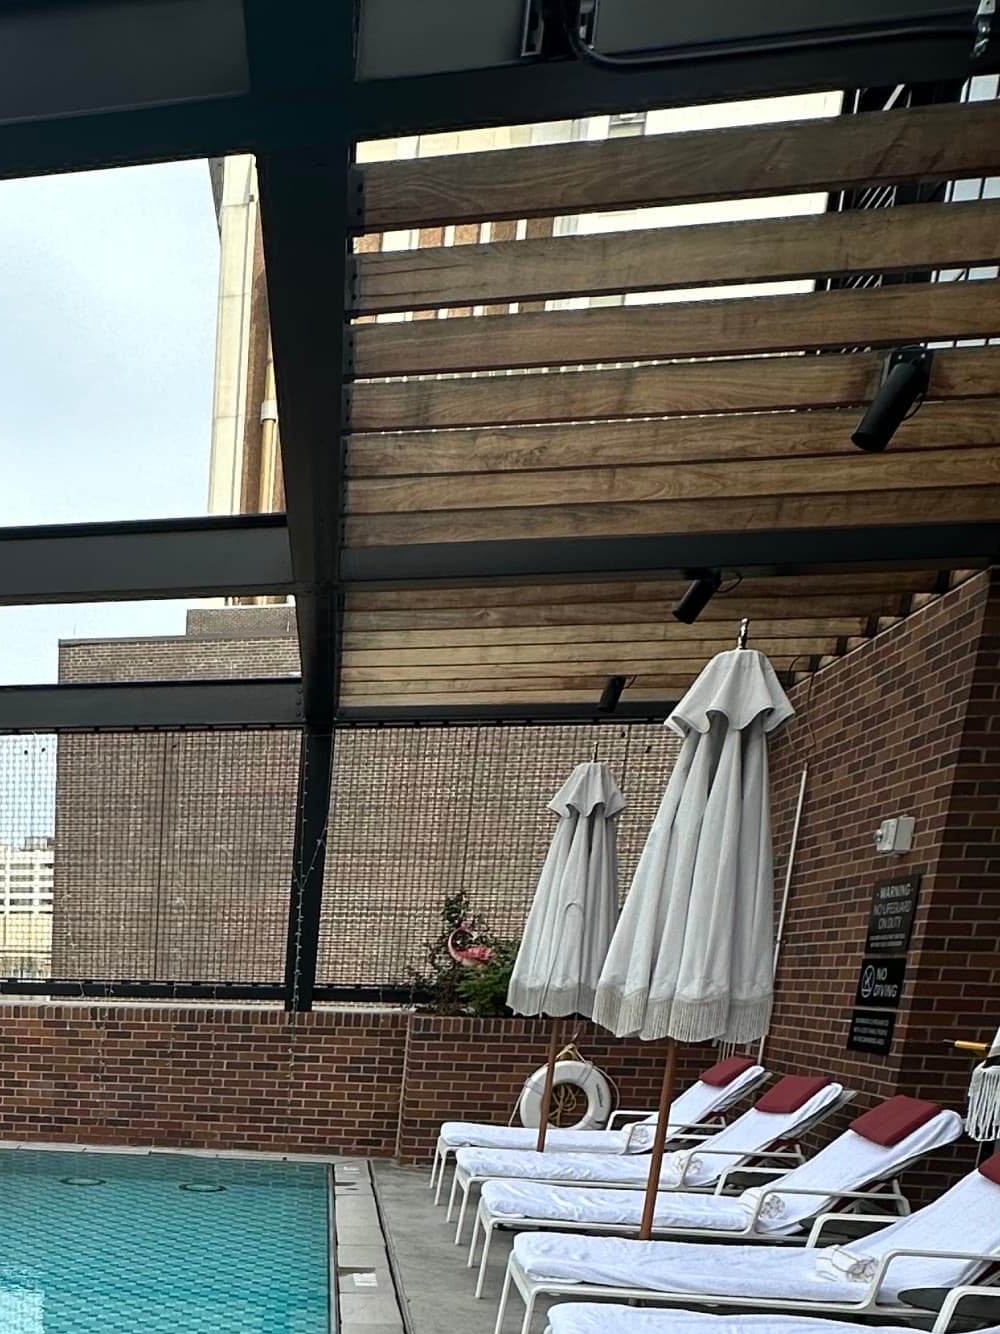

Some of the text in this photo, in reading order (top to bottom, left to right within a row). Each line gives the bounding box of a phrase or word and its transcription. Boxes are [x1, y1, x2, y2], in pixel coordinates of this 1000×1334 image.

[880, 883, 911, 899] WARNING
[873, 900, 912, 917] NO LIFEGUARD
[878, 917, 887, 930] ON
[876, 967, 888, 981] NO
[873, 984, 898, 998] DIVING
